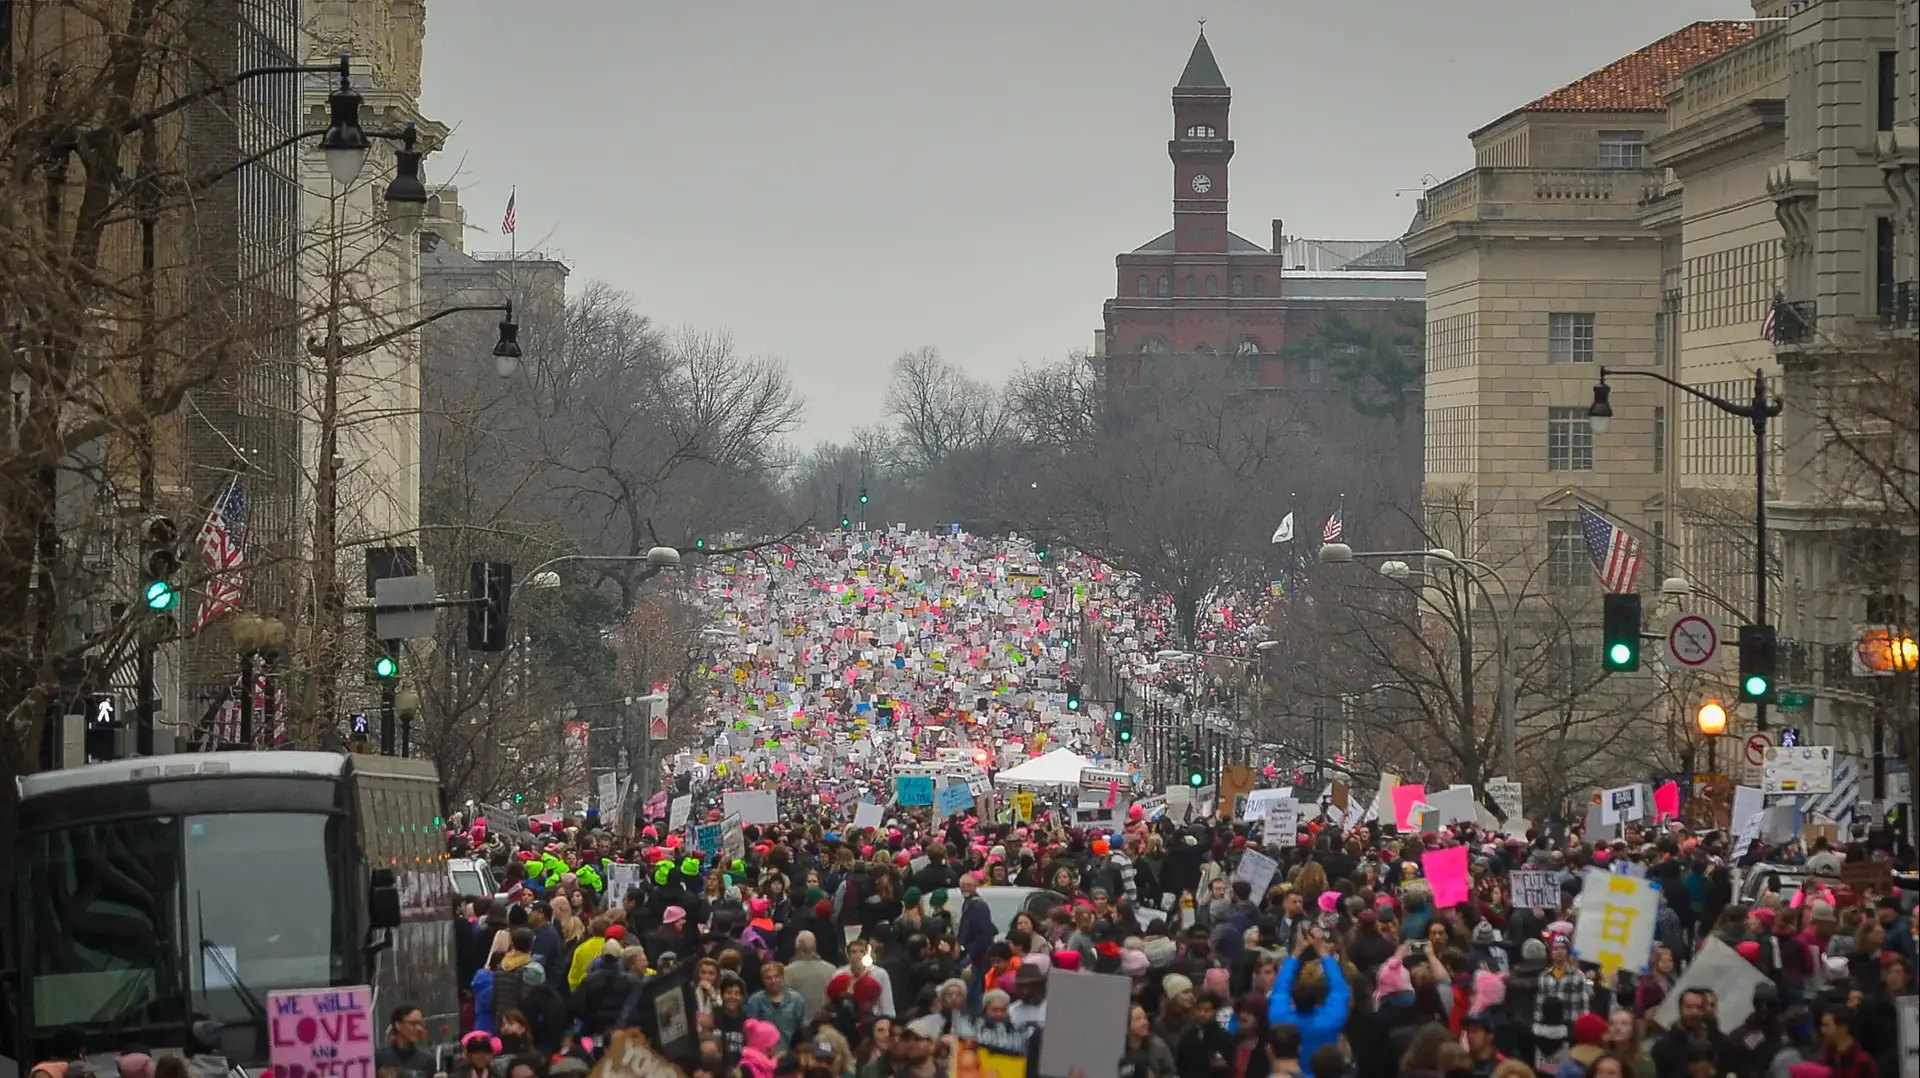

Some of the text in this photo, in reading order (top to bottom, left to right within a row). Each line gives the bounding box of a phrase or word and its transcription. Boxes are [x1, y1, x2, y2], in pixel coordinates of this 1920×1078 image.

[1522, 872, 1559, 888] FUTURE
[1524, 888, 1559, 907] FEMALE
[275, 991, 363, 1014] WE WILL
[273, 1012, 369, 1048] LOVE
[311, 1046, 339, 1059] AND
